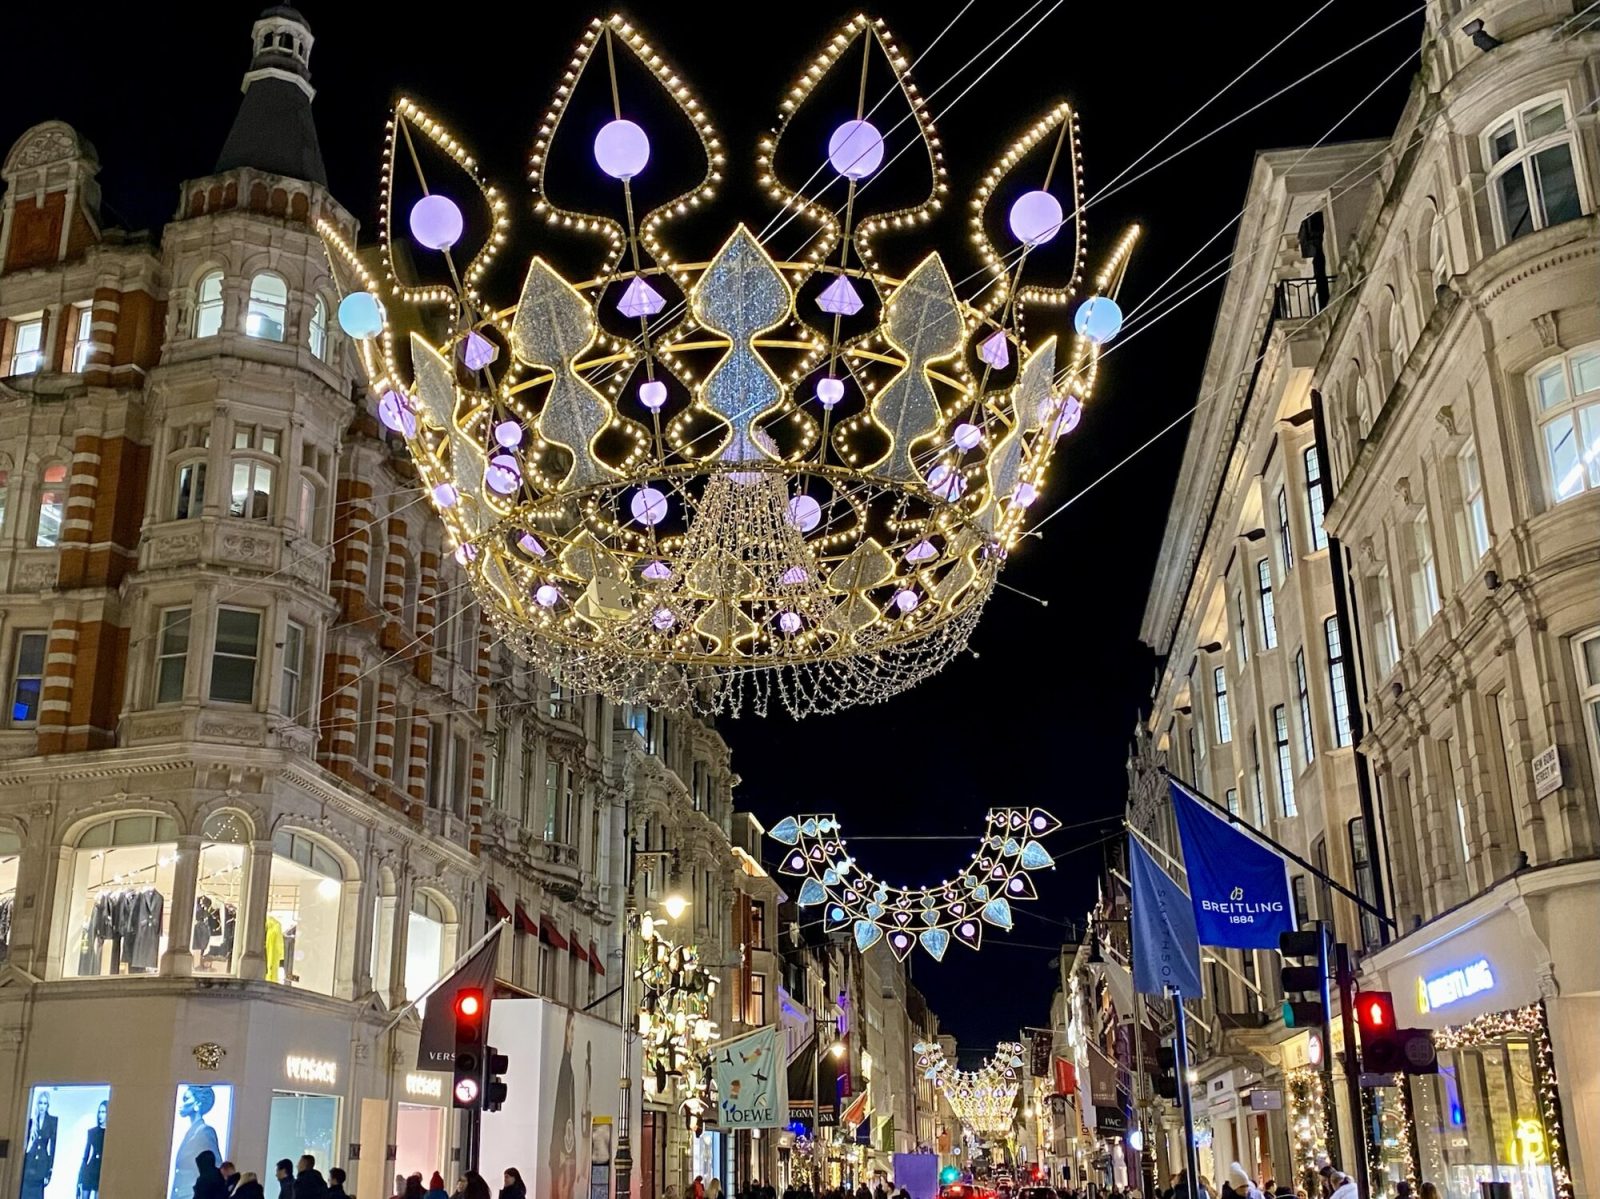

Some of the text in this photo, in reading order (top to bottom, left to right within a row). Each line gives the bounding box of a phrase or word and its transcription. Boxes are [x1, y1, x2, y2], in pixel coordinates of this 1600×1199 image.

[1543, 749, 1555, 766] BOND
[1535, 766, 1550, 784] STREET
[1201, 900, 1283, 914] BREITLING
[1229, 915, 1255, 924] 1884
[286, 1055, 337, 1085] VERSACE
[725, 1108, 774, 1123] LOEWE
[1104, 1117, 1121, 1126] IWC
